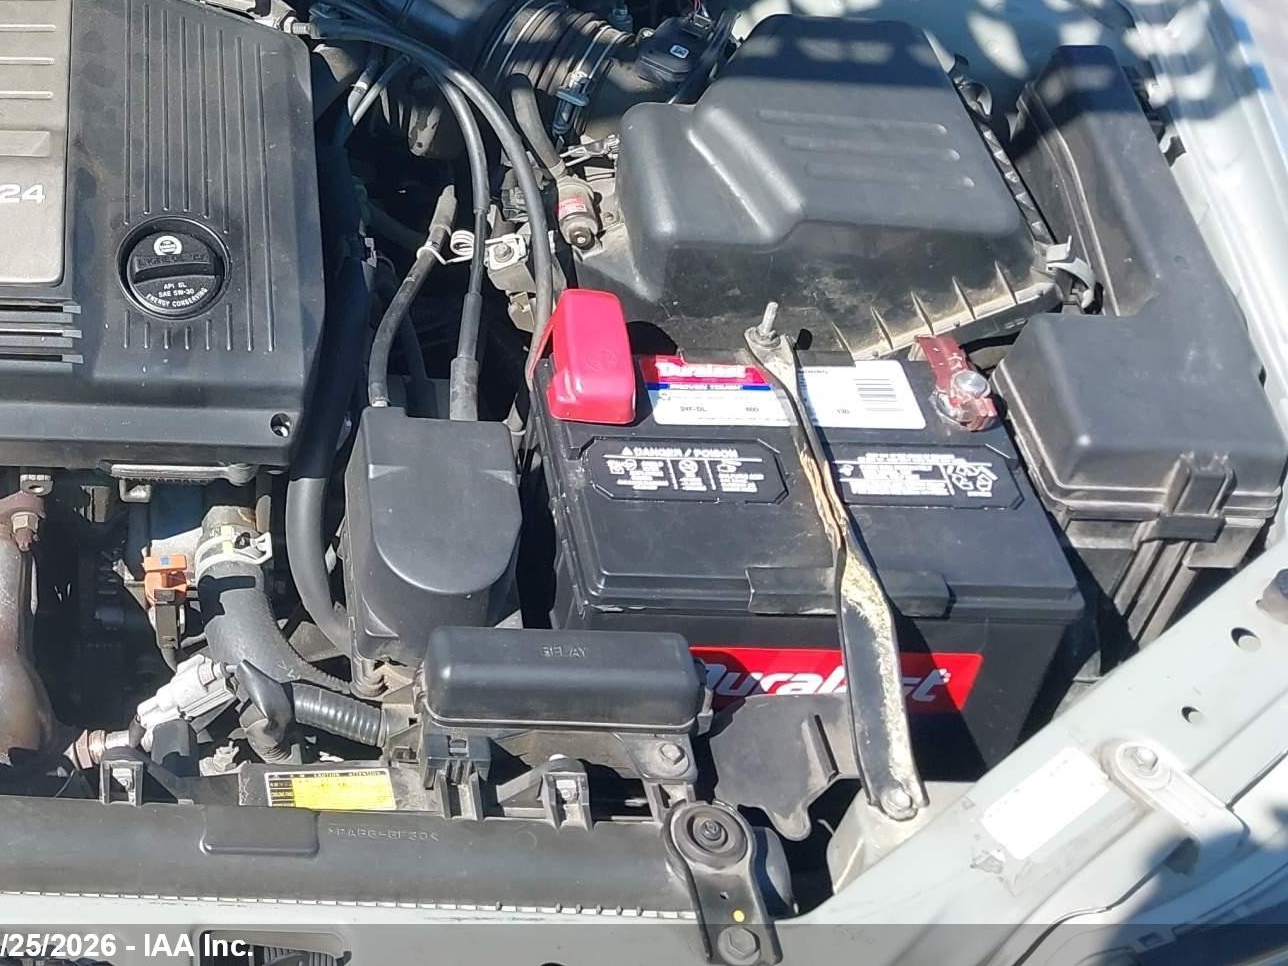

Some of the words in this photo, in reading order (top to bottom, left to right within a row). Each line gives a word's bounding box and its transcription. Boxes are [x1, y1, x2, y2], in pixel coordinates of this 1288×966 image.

[145, 293, 170, 307] ENERGY
[172, 287, 208, 307] CONSERVING
[173, 288, 195, 296] 5W-30
[633, 447, 683, 458] DANGER
[693, 448, 739, 459] POISON
[542, 645, 586, 657] RELAY
